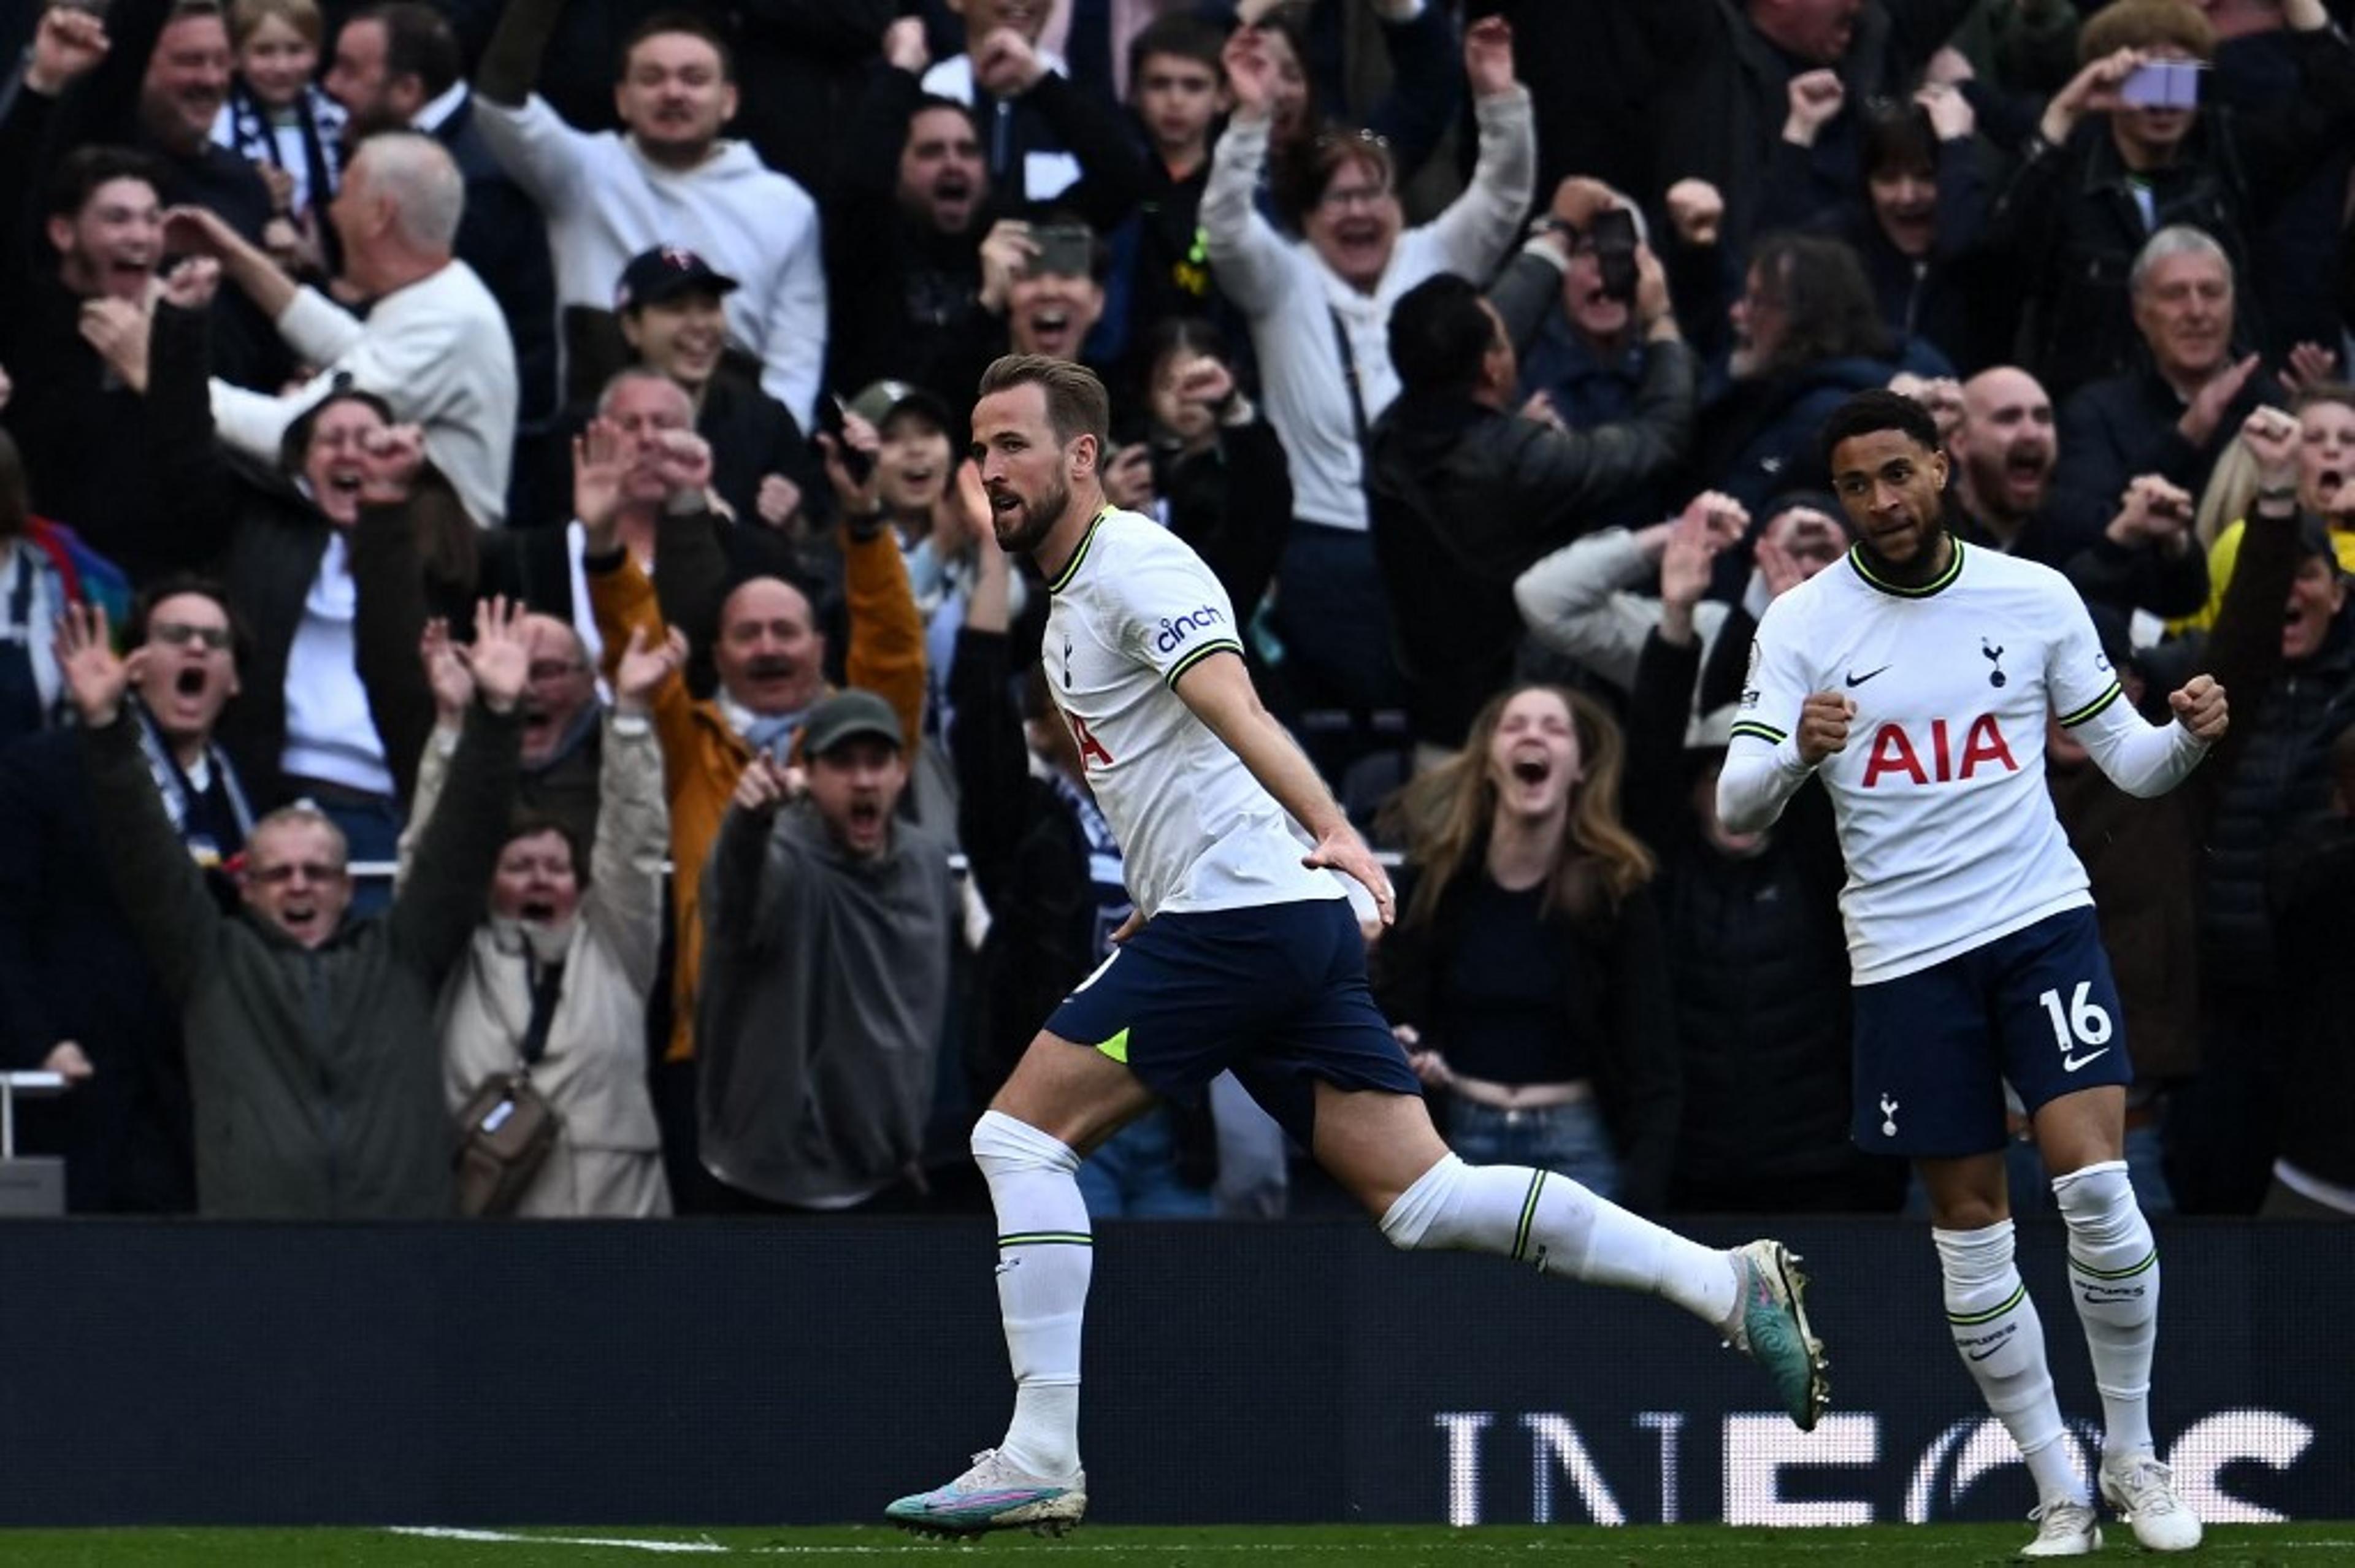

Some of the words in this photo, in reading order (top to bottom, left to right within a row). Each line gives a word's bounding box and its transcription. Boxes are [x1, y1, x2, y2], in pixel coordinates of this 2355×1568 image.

[1157, 604, 1226, 653] cinch
[1863, 713, 2018, 788] AIA
[2040, 981, 2112, 1052] 16
